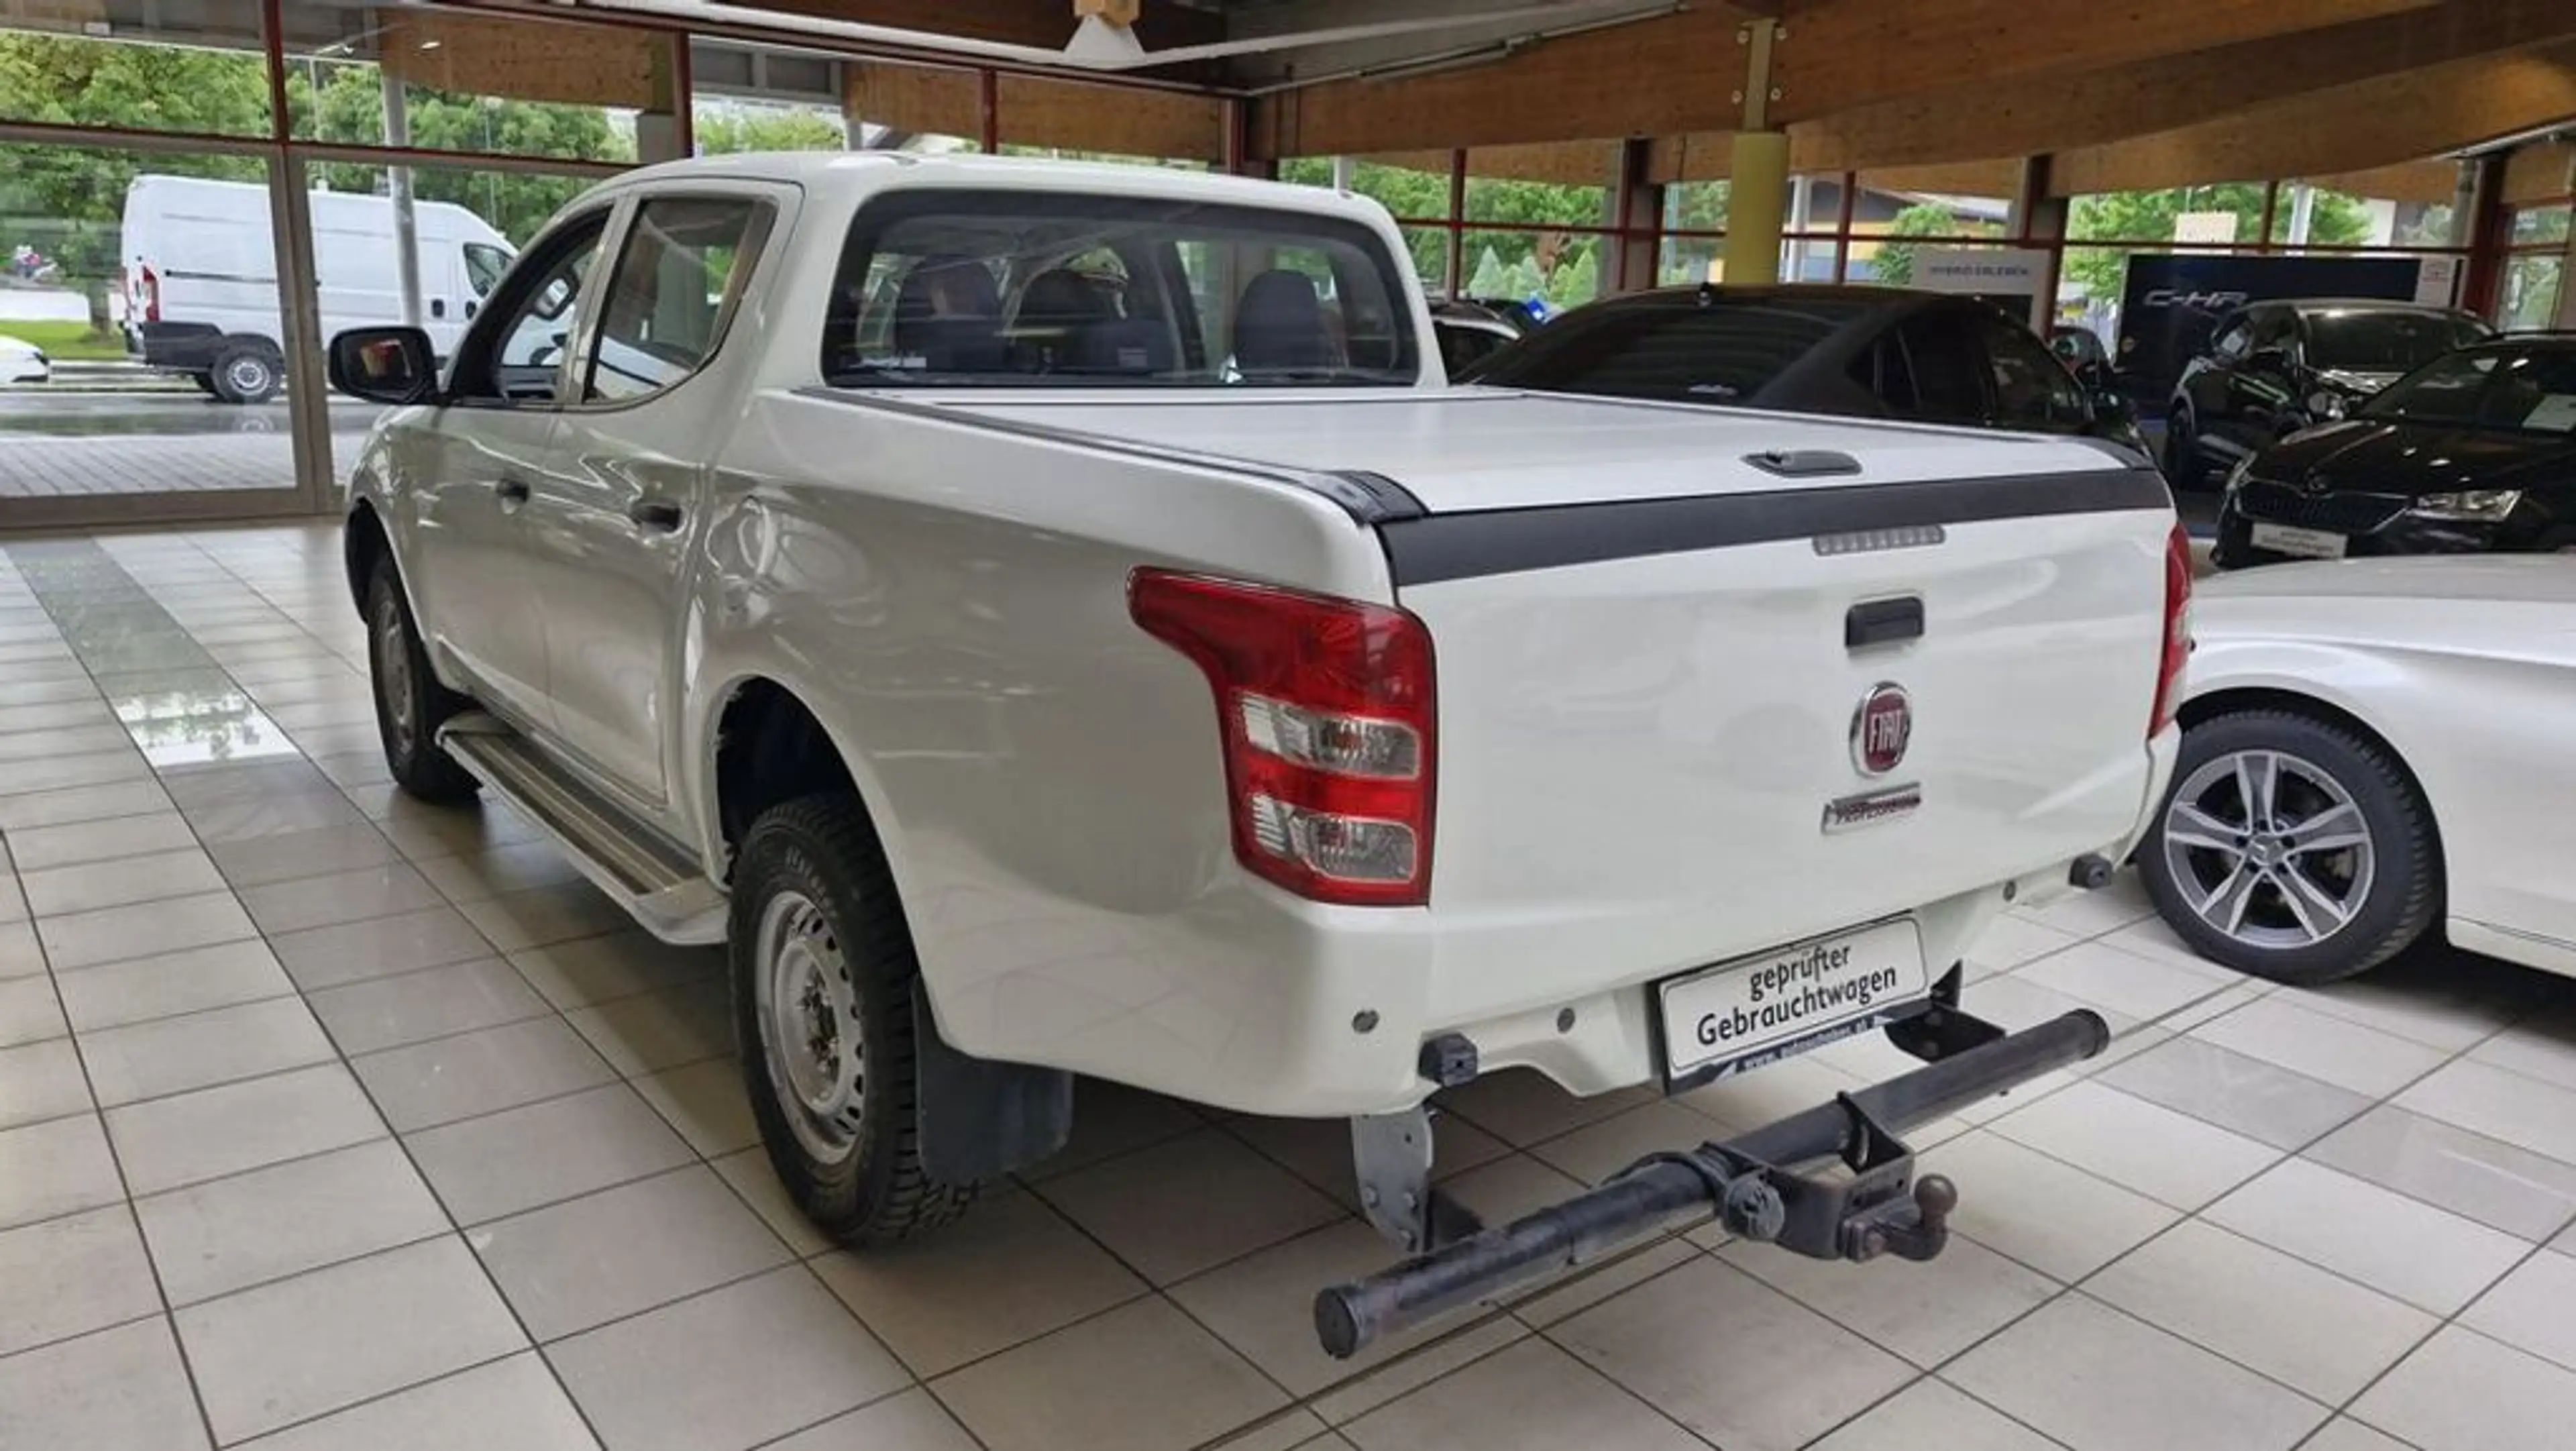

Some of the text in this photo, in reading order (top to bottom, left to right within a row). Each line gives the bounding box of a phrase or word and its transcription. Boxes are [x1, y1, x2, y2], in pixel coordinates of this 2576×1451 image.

[2143, 289, 2249, 307] C-HR
[1868, 708, 1904, 754] FIAT
[1750, 945, 1851, 1002] geprüfter
[1697, 966, 1896, 1046] Gebrauchtwagen
